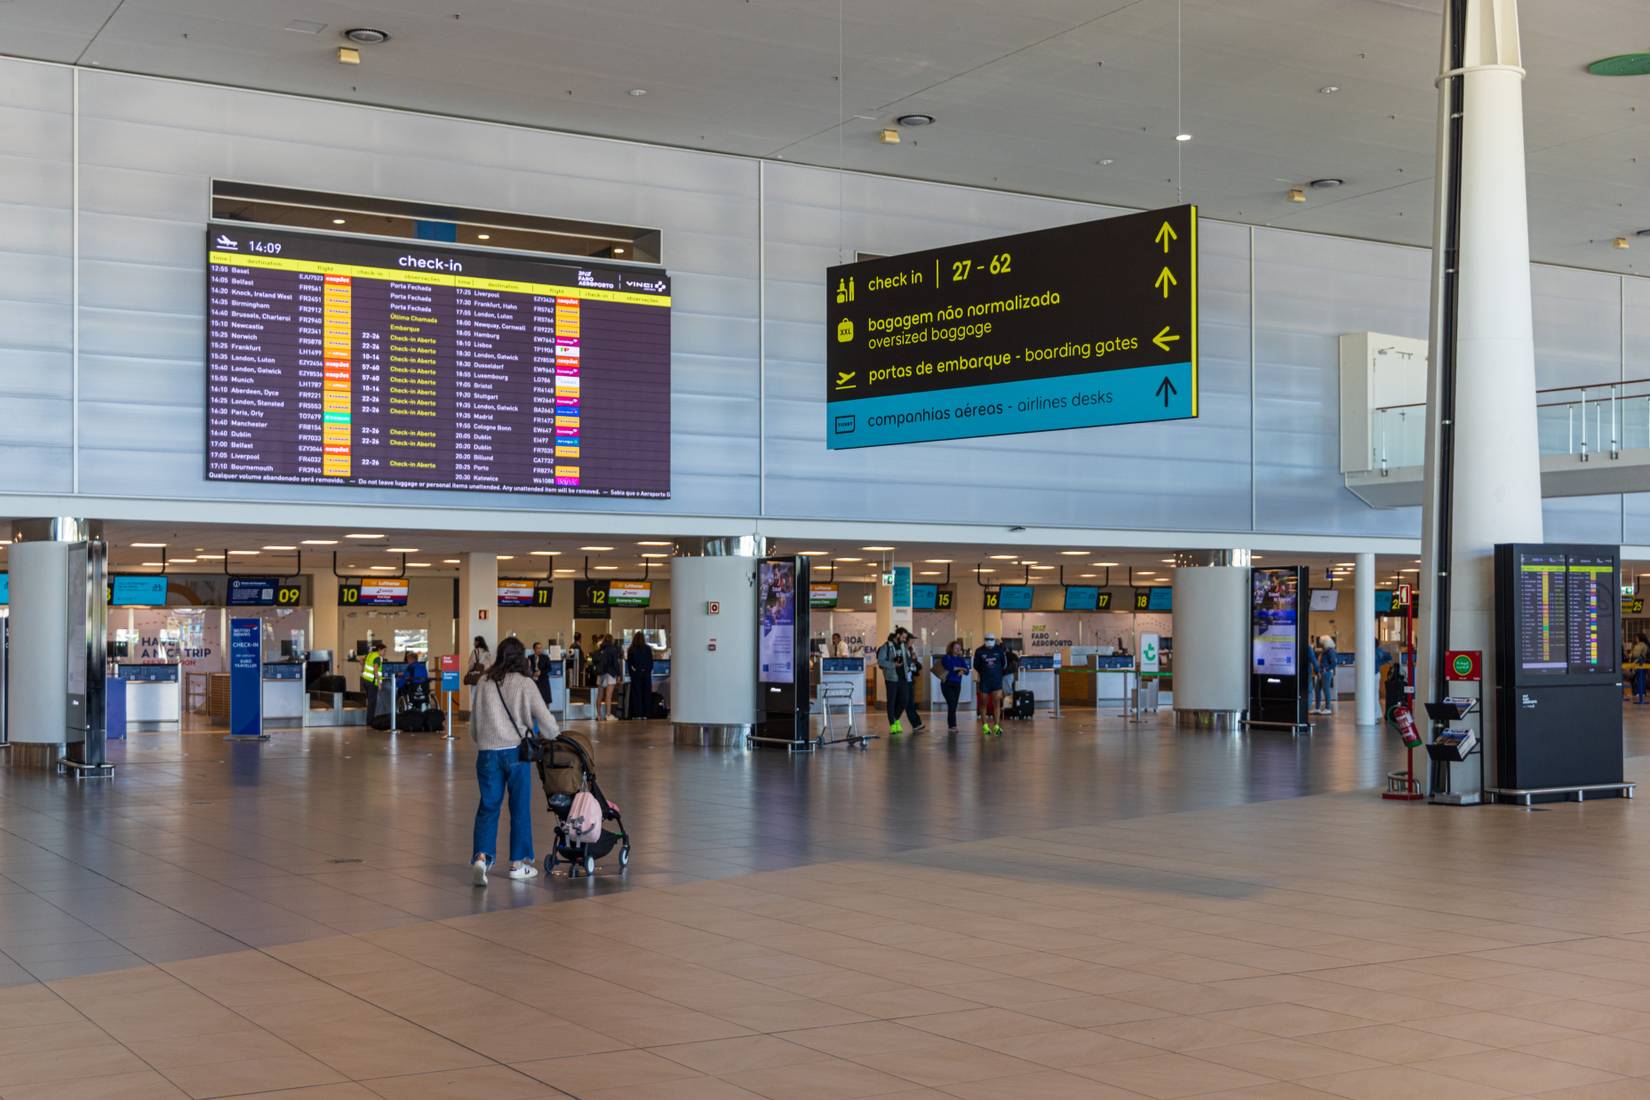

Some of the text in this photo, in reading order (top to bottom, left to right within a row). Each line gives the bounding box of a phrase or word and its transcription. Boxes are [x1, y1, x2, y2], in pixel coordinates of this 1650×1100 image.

[249, 241, 282, 254] 14:09
[398, 255, 463, 272] check-in
[868, 272, 907, 292] check
[911, 270, 923, 284] in
[952, 260, 972, 282] 27
[989, 252, 1012, 276] 62
[407, 283, 432, 292] Fechada
[578, 281, 614, 289] AEROPORTO
[407, 294, 432, 302] Fechada
[407, 304, 432, 312] Fechada
[868, 290, 1060, 333] bagagem não normalizada
[390, 323, 420, 333] Embarque
[390, 334, 416, 342] Check-in
[868, 322, 992, 350] oversized baggage
[390, 344, 416, 352] Check-in
[389, 355, 416, 363] Check-in
[868, 365, 912, 385] portas
[916, 361, 933, 376] de
[936, 355, 1012, 373] embarque
[1025, 342, 1091, 362] boarding
[1095, 336, 1138, 357] gates
[389, 365, 416, 373] Check-in
[868, 407, 950, 428] companhias
[954, 402, 1003, 418] aéreas
[1017, 395, 1067, 412] airlines
[1071, 390, 1113, 407] desks
[209, 471, 238, 480] Qualquer
[394, 480, 418, 488] luggage
[279, 589, 299, 603] 09
[343, 588, 358, 602] 10
[538, 590, 548, 604] 11
[592, 590, 606, 604] 12
[938, 594, 950, 606] 15
[986, 595, 998, 606] 16
[1099, 595, 1108, 607] 17
[1137, 595, 1148, 608] 18
[1633, 601, 1642, 611] 25
[141, 648, 150, 658] A
[184, 648, 211, 657] TRIP
